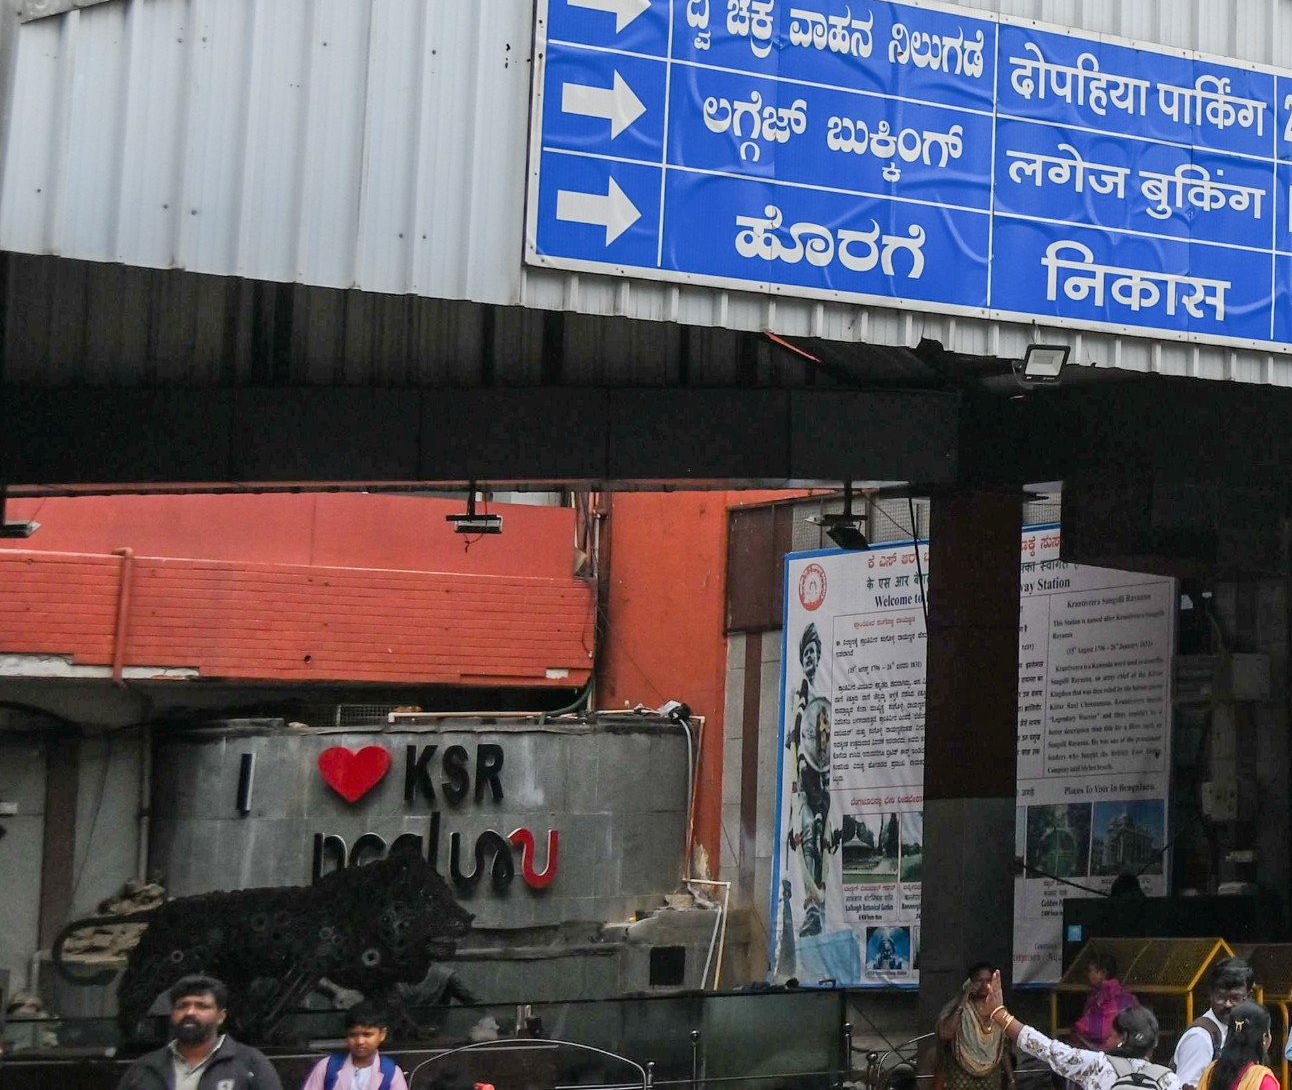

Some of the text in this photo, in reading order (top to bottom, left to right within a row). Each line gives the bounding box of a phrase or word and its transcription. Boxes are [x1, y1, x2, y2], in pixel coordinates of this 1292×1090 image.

[789, 5, 873, 58] ವಾಹನ
[888, 22, 985, 79] ನಿಲುಗಡೆ
[1158, 75, 1266, 136] पार्किंग
[827, 116, 963, 183] ಬುಕ್ಕಿಂಗ್
[1006, 143, 1266, 220] लगेज बुकिंग
[735, 204, 926, 280] ಹೊರಗೆ
[1041, 239, 1231, 321] निकास
[875, 595, 913, 608] Welcome
[1037, 577, 1070, 591] Station
[236, 753, 256, 812] I
[403, 743, 505, 805] KSR
